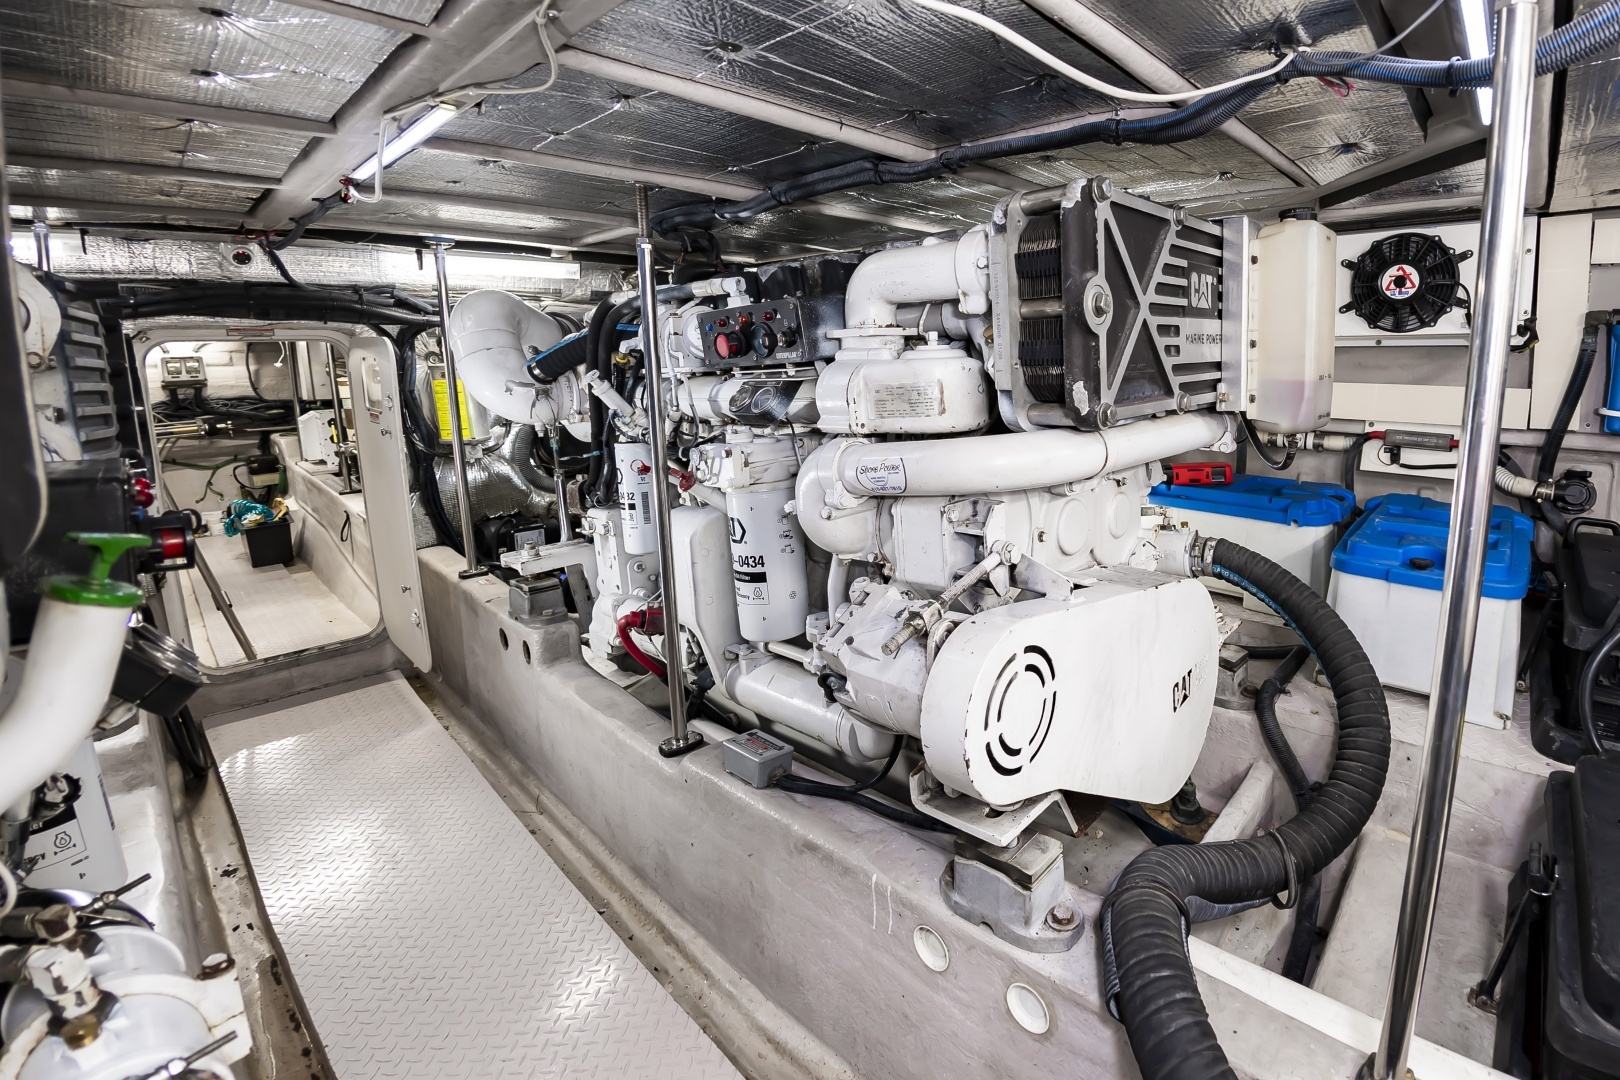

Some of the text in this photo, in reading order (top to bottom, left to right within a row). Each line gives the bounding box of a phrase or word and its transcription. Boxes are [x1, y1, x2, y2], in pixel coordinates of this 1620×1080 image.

[1189, 271, 1213, 309] CAT
[1185, 333, 1205, 345] MARINE
[733, 554, 765, 569] -0434
[1172, 667, 1192, 713] CAT
